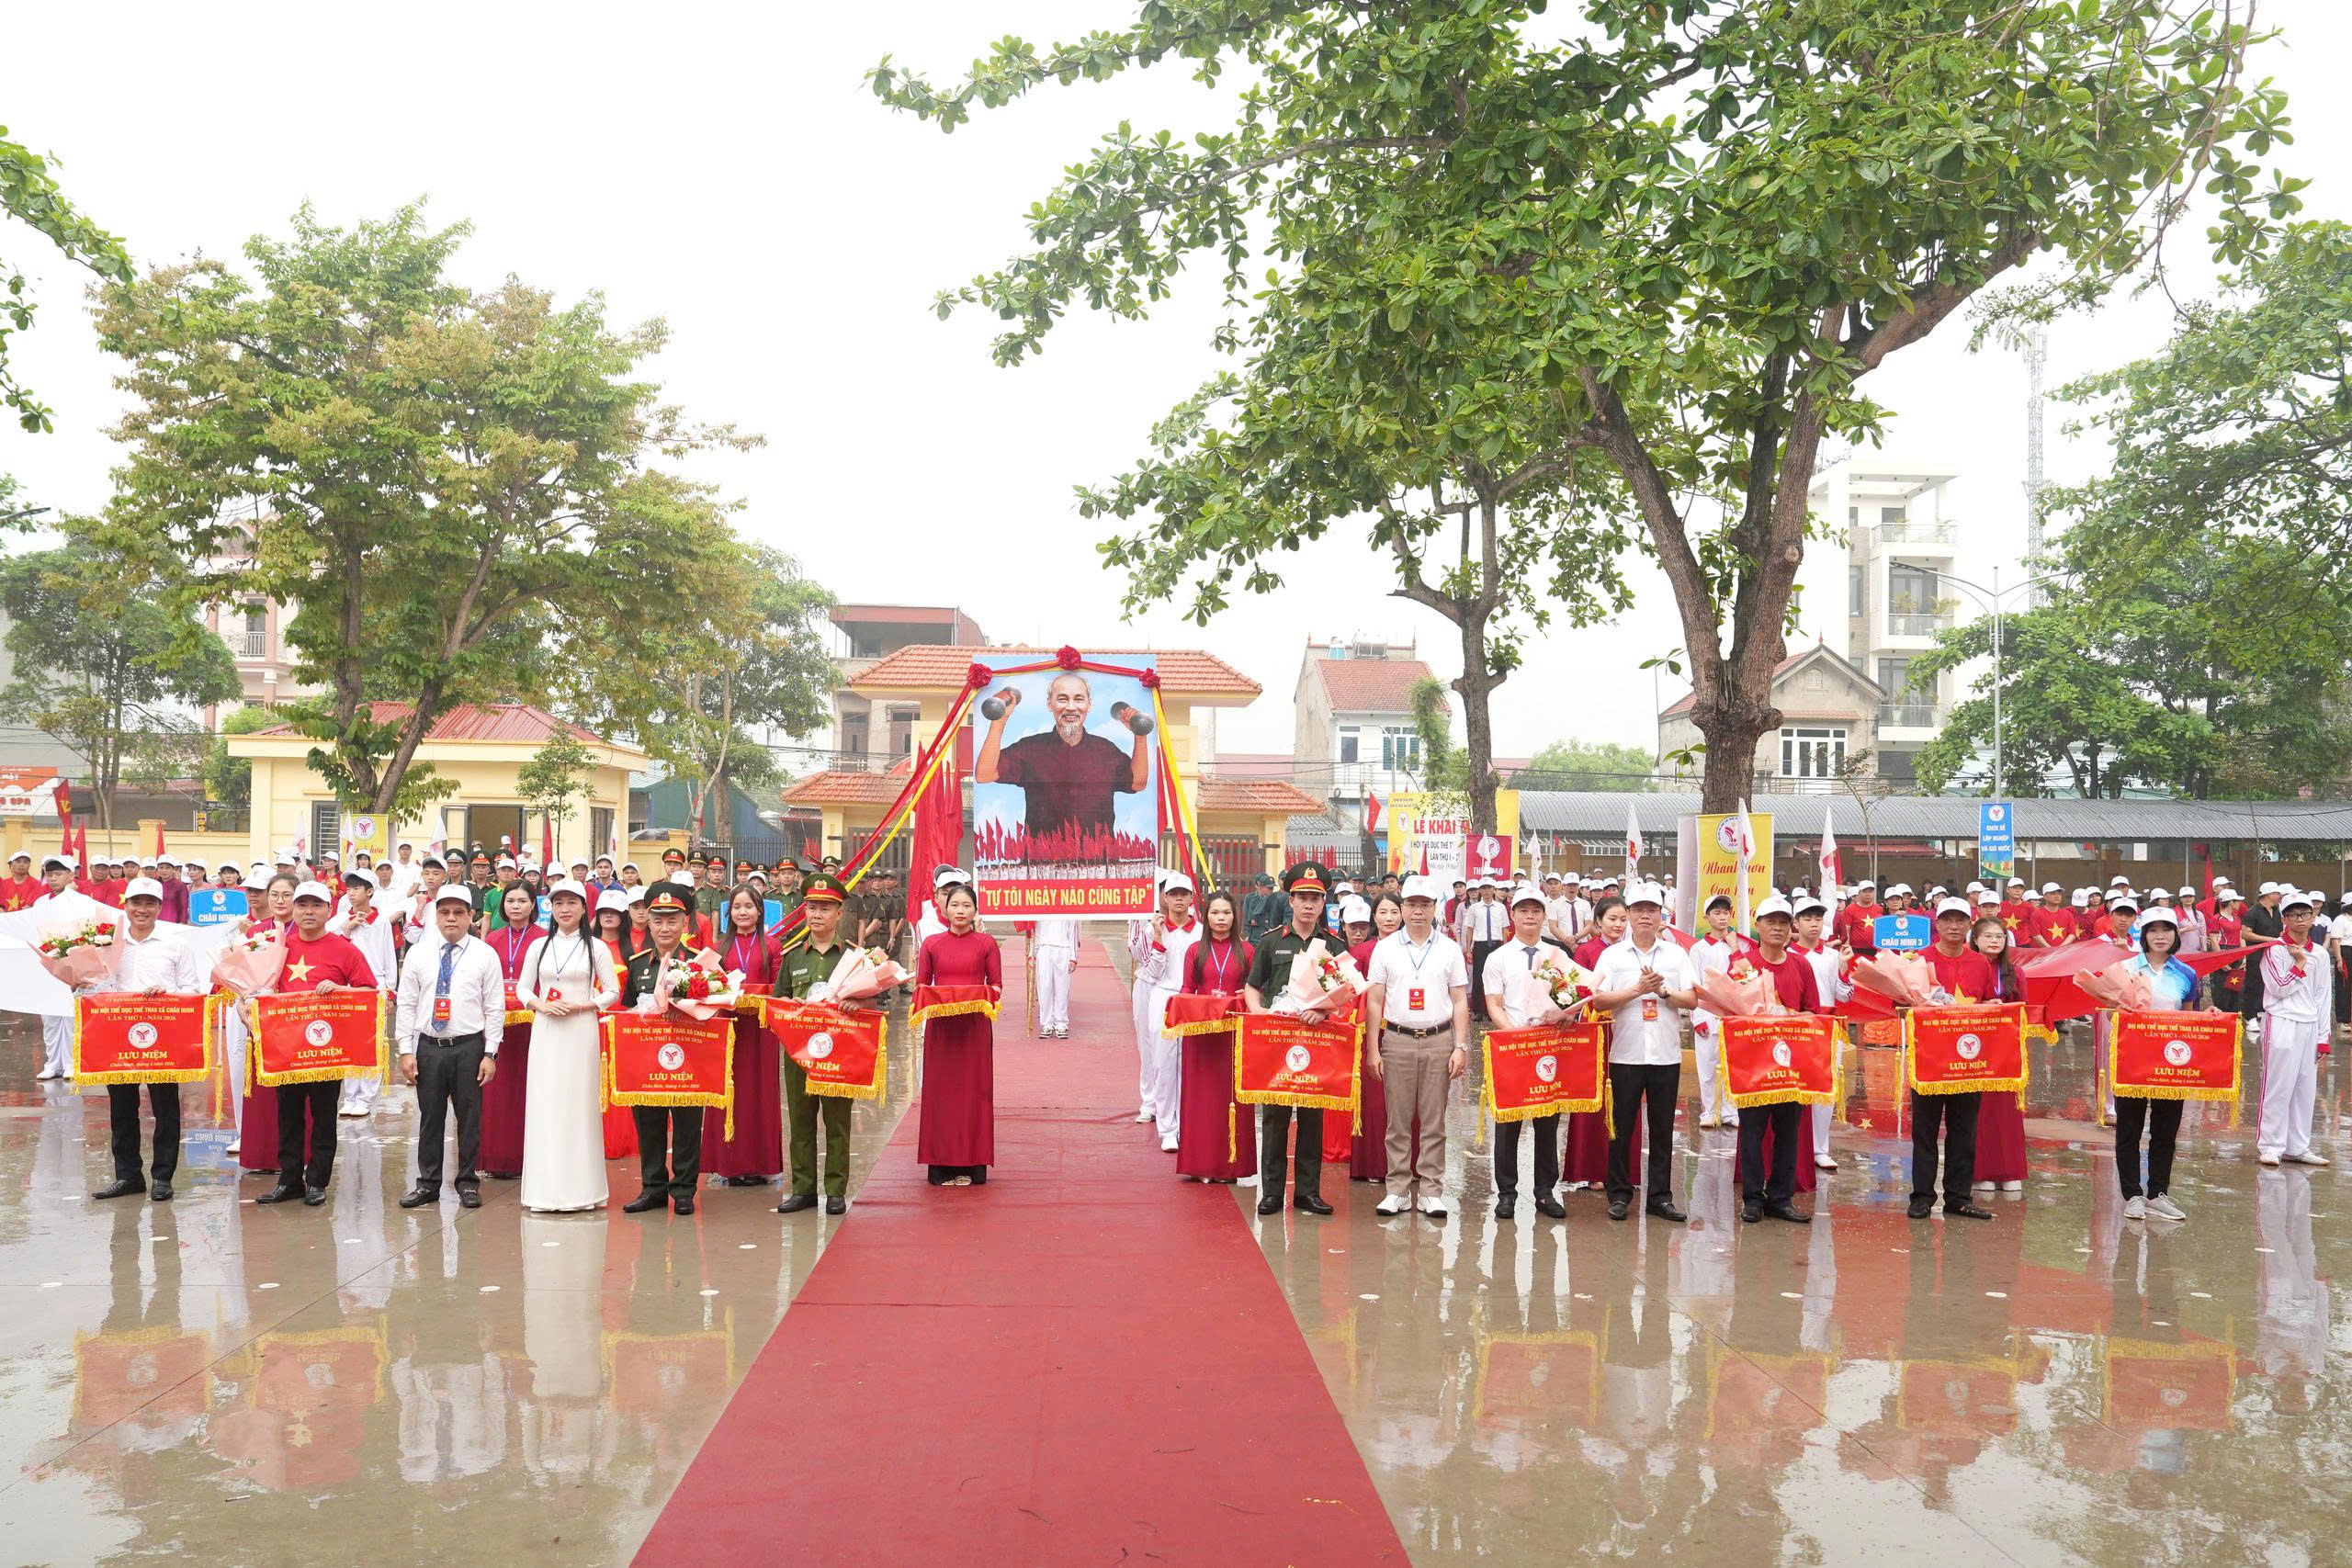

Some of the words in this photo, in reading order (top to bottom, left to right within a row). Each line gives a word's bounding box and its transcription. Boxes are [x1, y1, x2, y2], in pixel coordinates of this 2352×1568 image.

[1429, 819, 1456, 834] KHAI
[1004, 886, 1022, 906] TÔI
[1025, 886, 1057, 907] NGÀY
[1060, 886, 1085, 906] NÀO
[1089, 886, 1121, 905] CŨNG
[198, 912, 217, 921] CHÂU
[1882, 937, 1899, 946] CHÂU
[1901, 938, 1917, 946] NINH
[1918, 938, 1923, 946] 3
[142, 1049, 167, 1060] NIỆM
[298, 1050, 317, 1058] LƯU
[321, 1048, 343, 1058] NIỆM
[816, 1061, 840, 1072] NIỆM
[1969, 1060, 1986, 1069] NIỆM
[671, 1071, 693, 1082] NIỆM
[1768, 1070, 1786, 1079] LƯU
[2177, 1067, 2199, 1077] NIỆM
[1276, 1073, 1292, 1081] LƯU
[1295, 1074, 1317, 1084] NIỆM
[1530, 1085, 1547, 1094] LƯU
